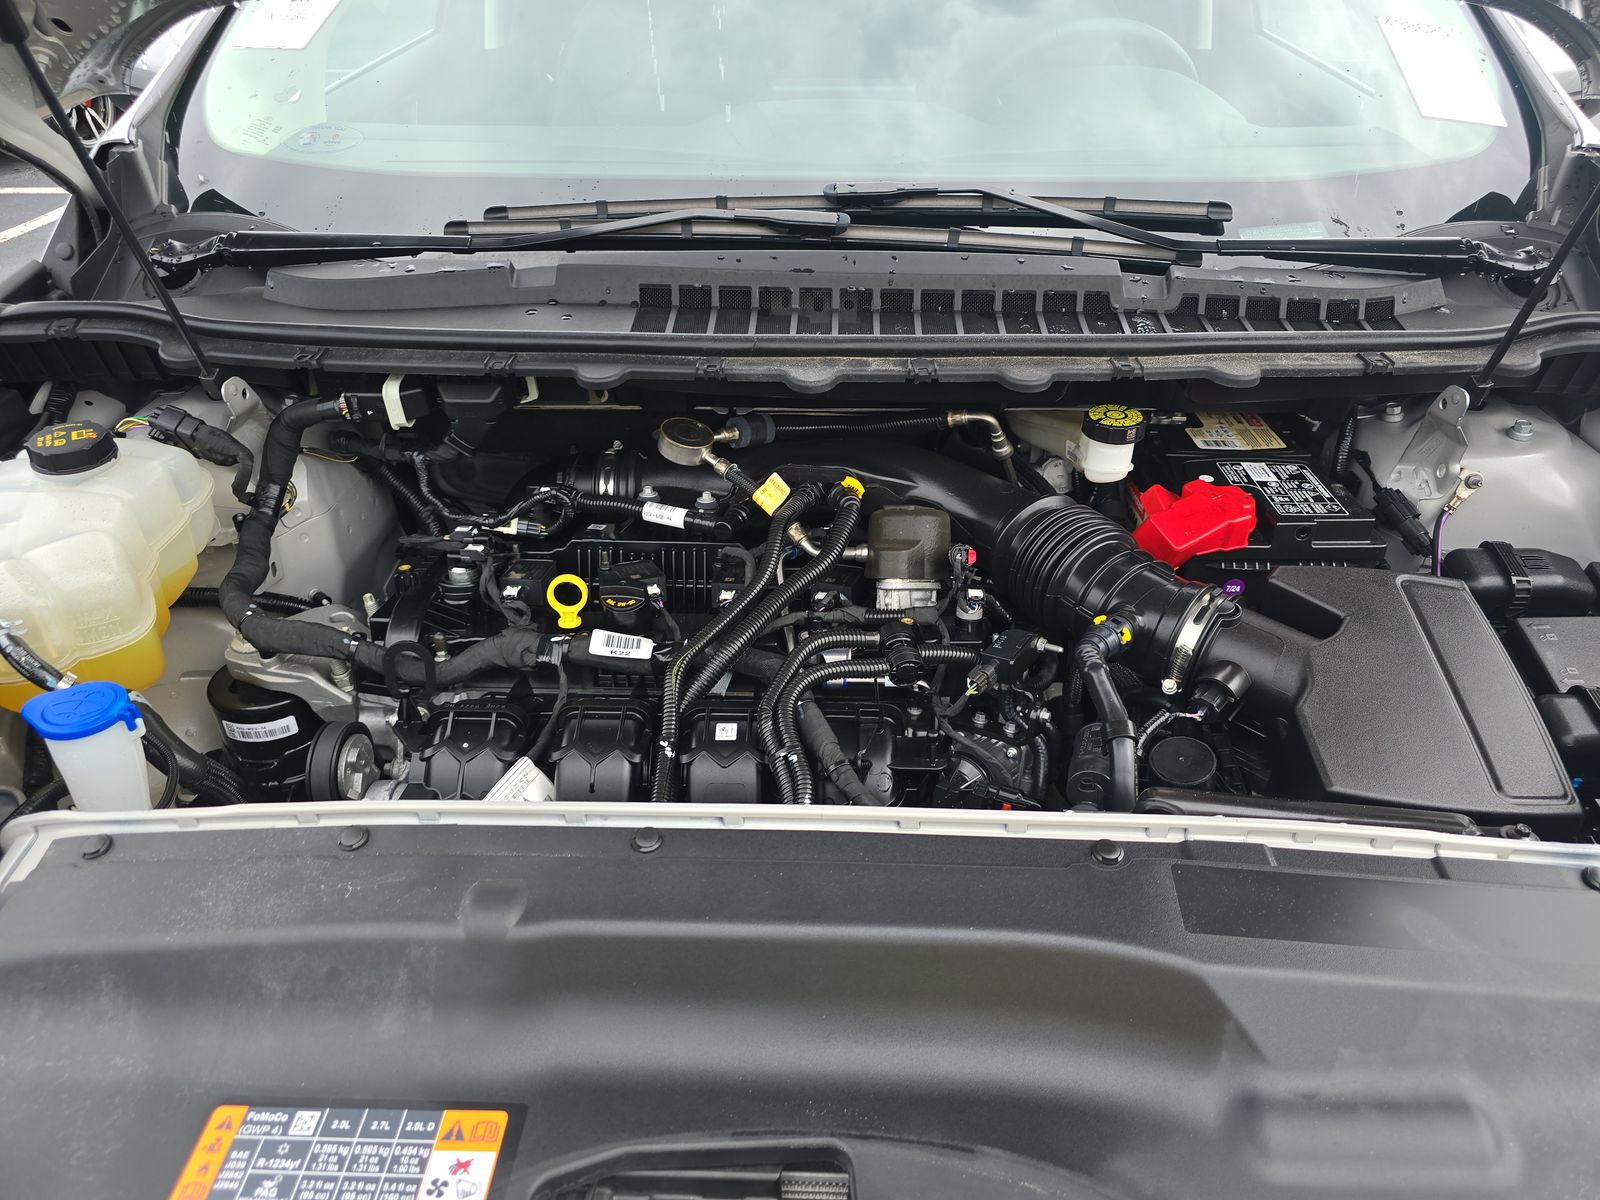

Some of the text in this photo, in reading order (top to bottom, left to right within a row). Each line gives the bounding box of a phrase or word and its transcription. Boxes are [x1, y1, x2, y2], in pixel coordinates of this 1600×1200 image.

[246, 1111, 289, 1122] FoMoCo
[331, 1120, 351, 1129] 2.0L
[371, 1121, 390, 1131] 2.7L
[405, 1122, 436, 1131] 2.0L D
[238, 1124, 283, 1136] (GWP 4)
[230, 1150, 251, 1160] SAE
[338, 1145, 350, 1157] kg
[354, 1144, 390, 1158] 0.595 kg
[394, 1145, 431, 1159] 0.454 kg
[256, 1157, 302, 1170] R-1234yf
[318, 1154, 339, 1163] 21 oz
[359, 1155, 379, 1164] 21 oz
[410, 1157, 420, 1165] oz
[311, 1163, 339, 1171] 1.31 lbs
[352, 1163, 380, 1172] 1.31 lbs
[409, 1165, 421, 1173] lbs
[301, 1180, 314, 1189] 3.2
[324, 1182, 335, 1190] oz
[342, 1180, 355, 1190] 3.2
[365, 1183, 377, 1191] oz
[383, 1182, 396, 1192] 5.4
[405, 1184, 418, 1192] oz
[254, 1186, 279, 1198] PAG
